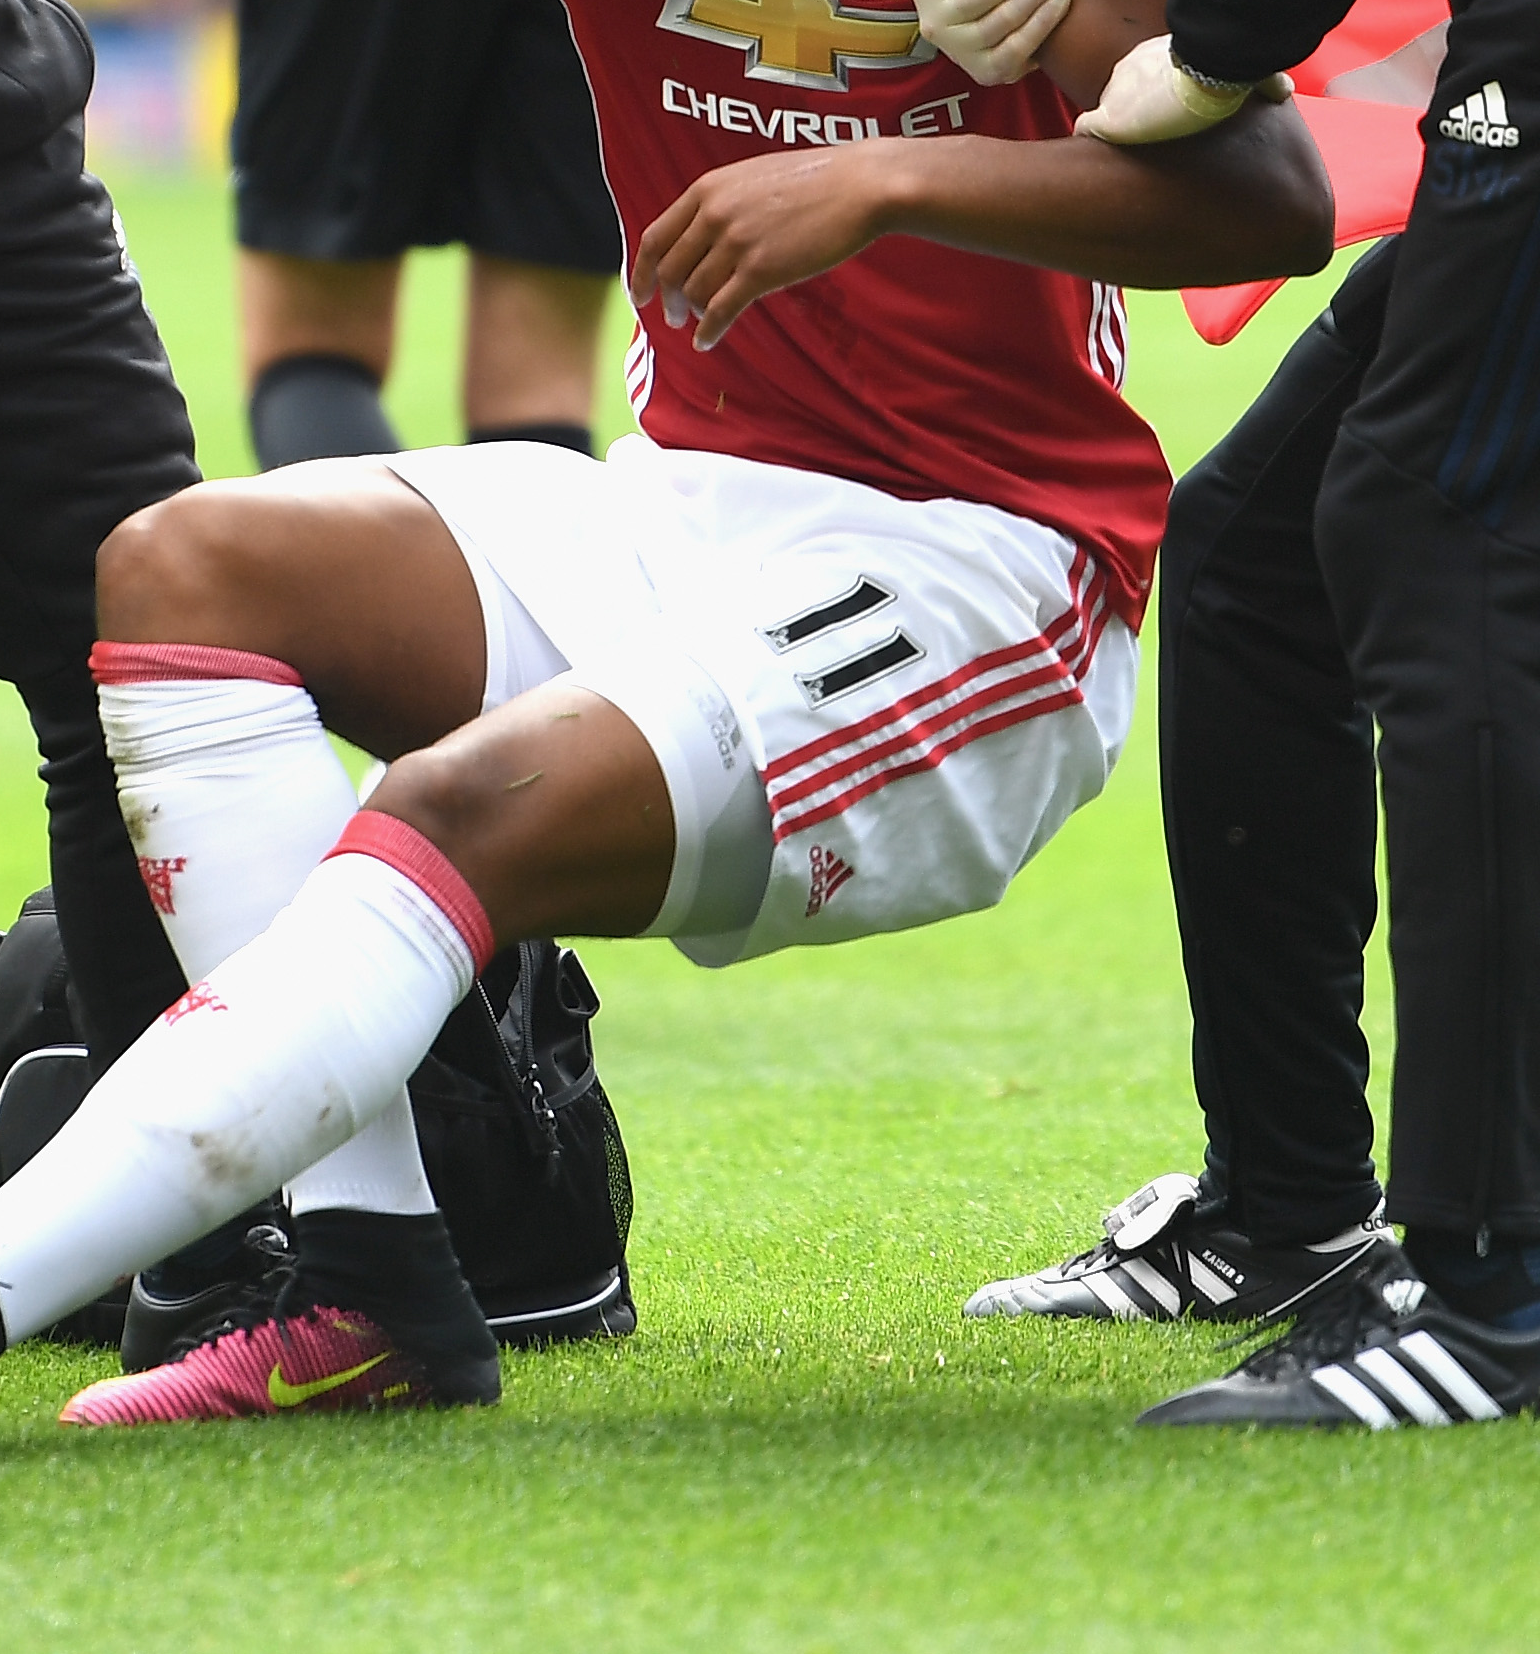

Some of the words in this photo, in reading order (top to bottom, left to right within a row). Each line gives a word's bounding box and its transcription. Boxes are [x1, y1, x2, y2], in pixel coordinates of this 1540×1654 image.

[661, 77, 970, 146] CHEVROLET
[1438, 117, 1521, 149] adidas
[755, 574, 927, 710] 11
[1201, 1249, 1236, 1279] KAISER
